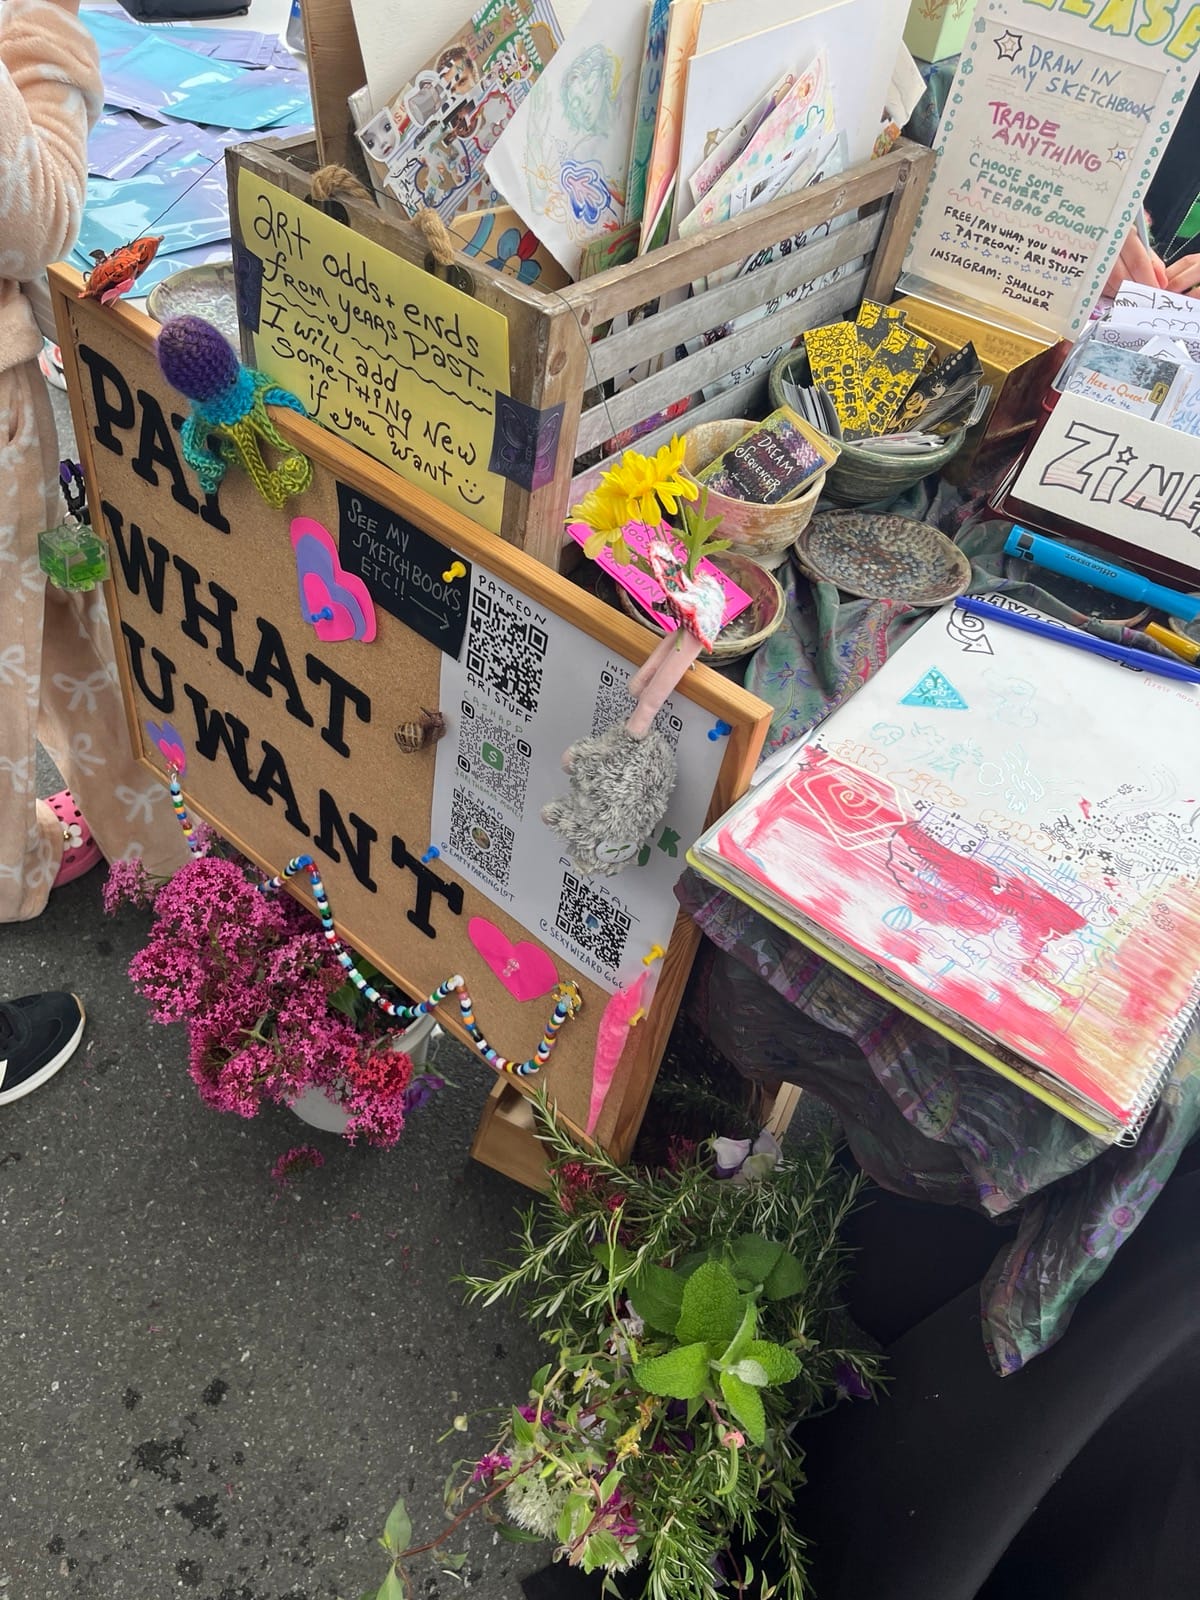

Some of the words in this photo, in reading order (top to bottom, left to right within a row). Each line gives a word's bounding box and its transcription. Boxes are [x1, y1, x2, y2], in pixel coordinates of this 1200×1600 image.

[1028, 44, 1084, 76] DRAW
[1090, 67, 1122, 87] IN
[988, 100, 1061, 139] TRADE
[1045, 77, 1156, 124] SKETCHBOOK
[991, 127, 1102, 173] ANYTHING
[969, 151, 1022, 183] CHOOSE
[1025, 174, 1065, 197] SOME
[976, 170, 1051, 204] FLOWERS
[1058, 199, 1086, 219] FOR
[960, 178, 971, 192] A
[981, 186, 1043, 217] TEABAG
[1044, 211, 1109, 242] BOUQUET
[943, 205, 997, 234] FREE/PAY
[999, 227, 1025, 243] WHAT
[1027, 238, 1048, 251] YOU
[1051, 246, 1089, 264] WANT
[955, 223, 1020, 256] PATREON:
[929, 247, 1002, 280] INSTAGRAM:
[1005, 274, 1055, 300] SHALLOT
[1001, 286, 1049, 311] FLOWER
[261, 300, 288, 332] I
[355, 355, 399, 392] add
[308, 374, 329, 417] if
[734, 445, 780, 502] SEQUENCER
[758, 434, 793, 476] DREAM
[347, 498, 378, 534] SEE
[385, 522, 409, 553] MY
[360, 556, 406, 600] ETC!!
[478, 575, 547, 625] PATREON
[101, 500, 371, 758] WHAT
[121, 621, 176, 714] U
[184, 684, 464, 939] WANT
[459, 784, 504, 821] VENMO
